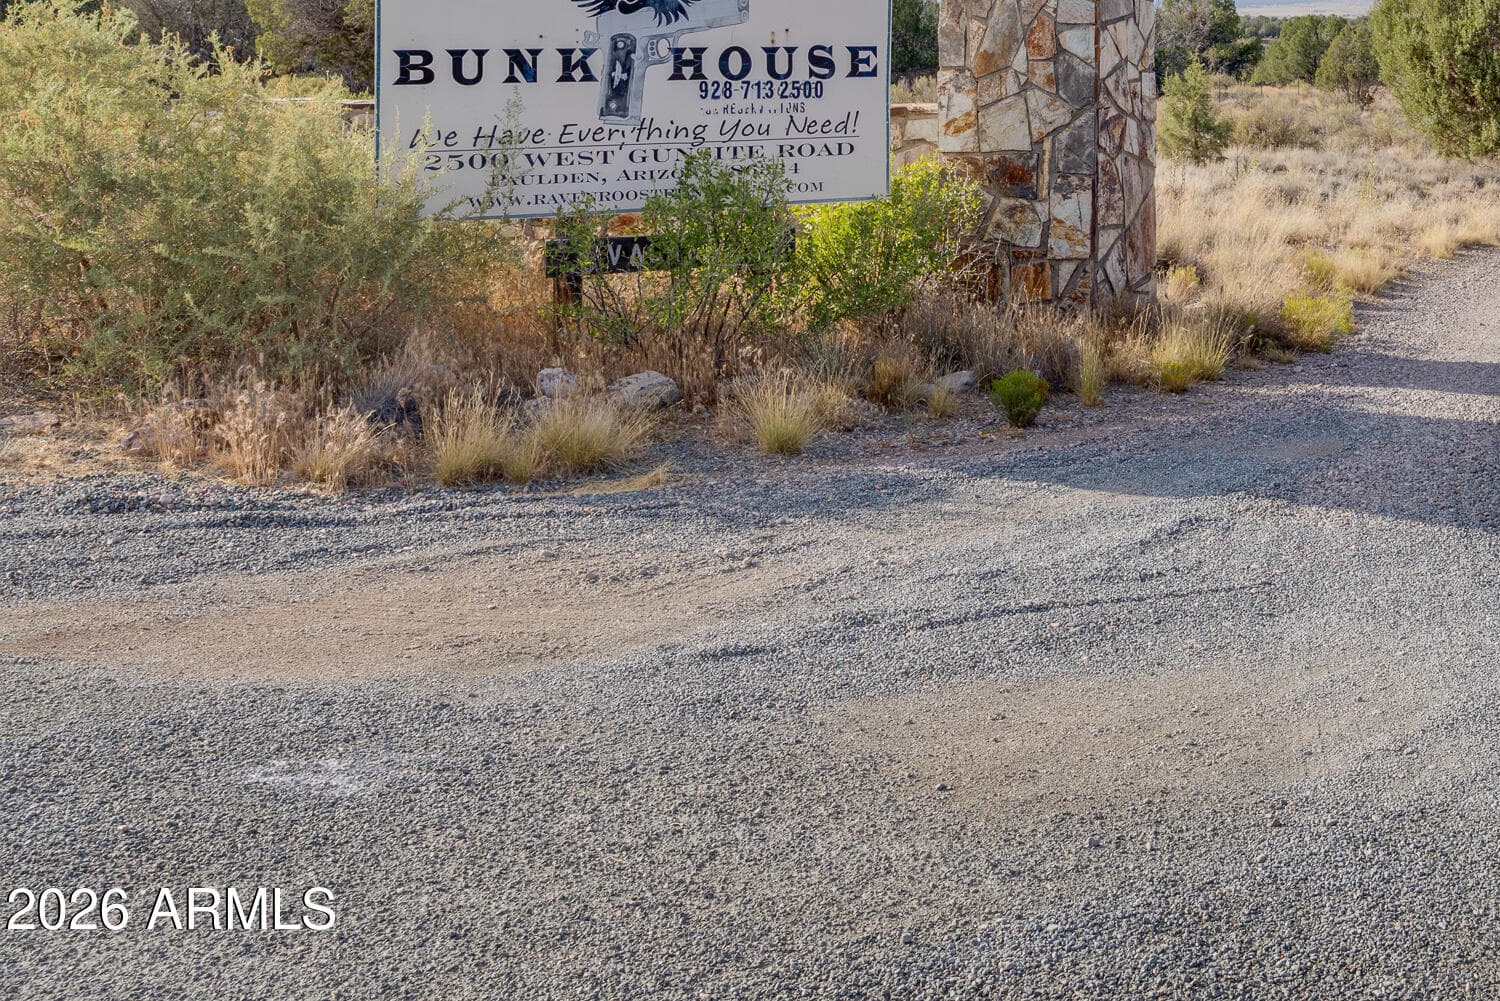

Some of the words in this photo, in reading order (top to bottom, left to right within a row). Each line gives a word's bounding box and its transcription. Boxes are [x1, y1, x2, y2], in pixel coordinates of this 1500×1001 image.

[391, 48, 600, 86] BUNK
[667, 45, 878, 81] HOUSE
[408, 128, 459, 149] We
[472, 123, 546, 148] Have
[558, 117, 709, 150] Everything
[719, 118, 771, 143] You
[785, 110, 860, 137] Need!
[423, 153, 508, 172] 2500
[523, 150, 615, 169] WEST
[628, 144, 765, 164] GUNSITE
[778, 141, 855, 159] ROAD
